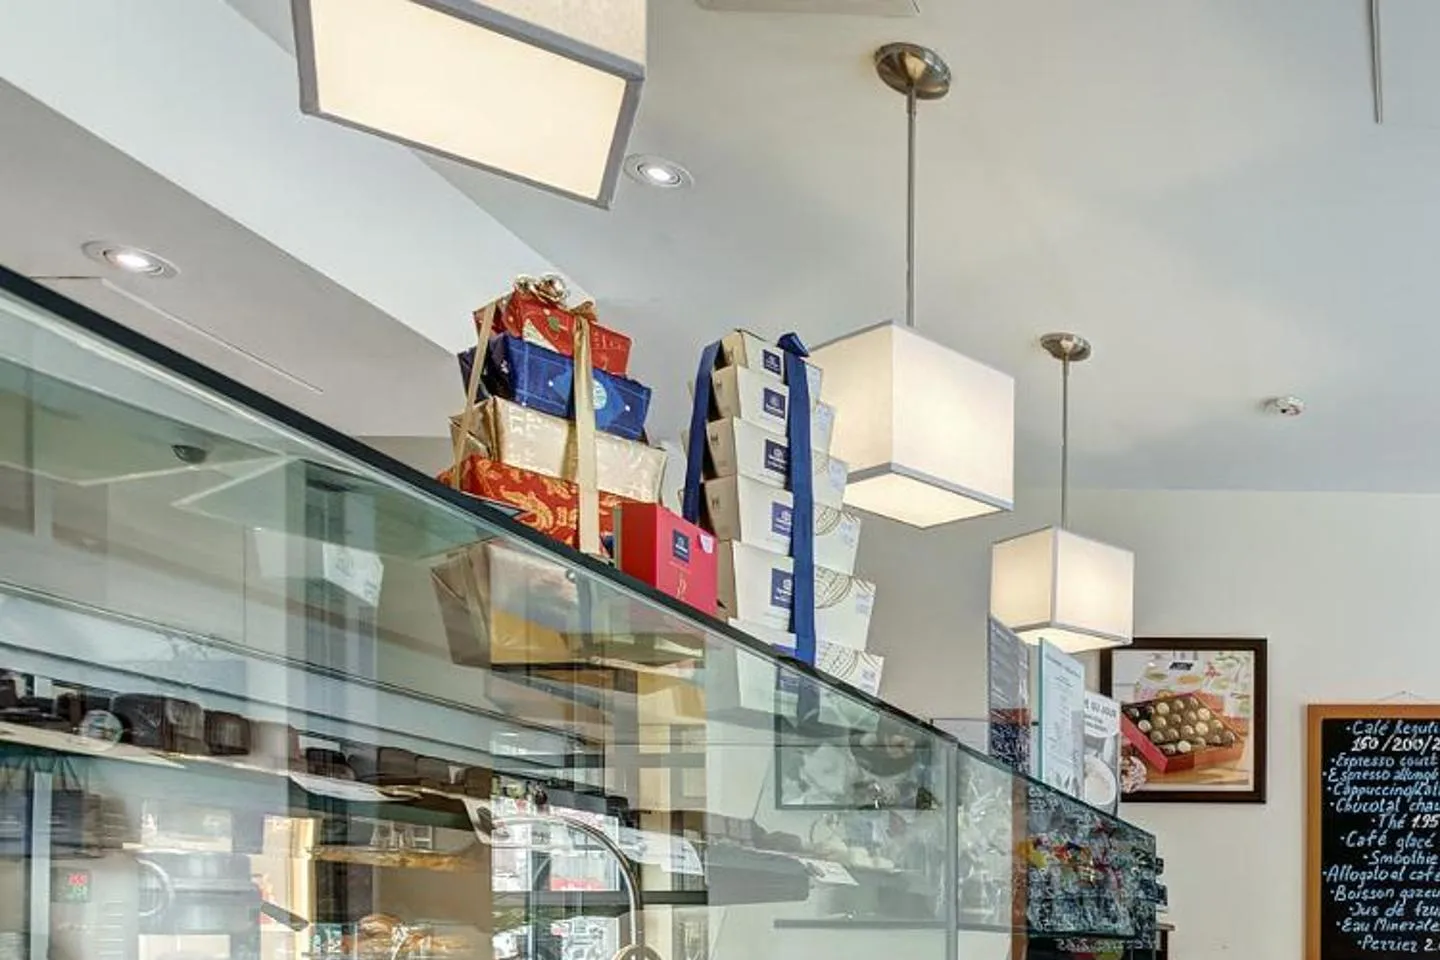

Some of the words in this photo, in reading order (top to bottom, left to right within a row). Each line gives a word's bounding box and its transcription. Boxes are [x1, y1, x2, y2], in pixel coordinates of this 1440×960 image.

[1352, 720, 1389, 736] Café
[1336, 752, 1395, 771] Espresso
[1379, 814, 1406, 828] Thé
[1345, 829, 1389, 848] Café
[1334, 884, 1395, 902] Boisson
[1341, 917, 1369, 933] Eau
